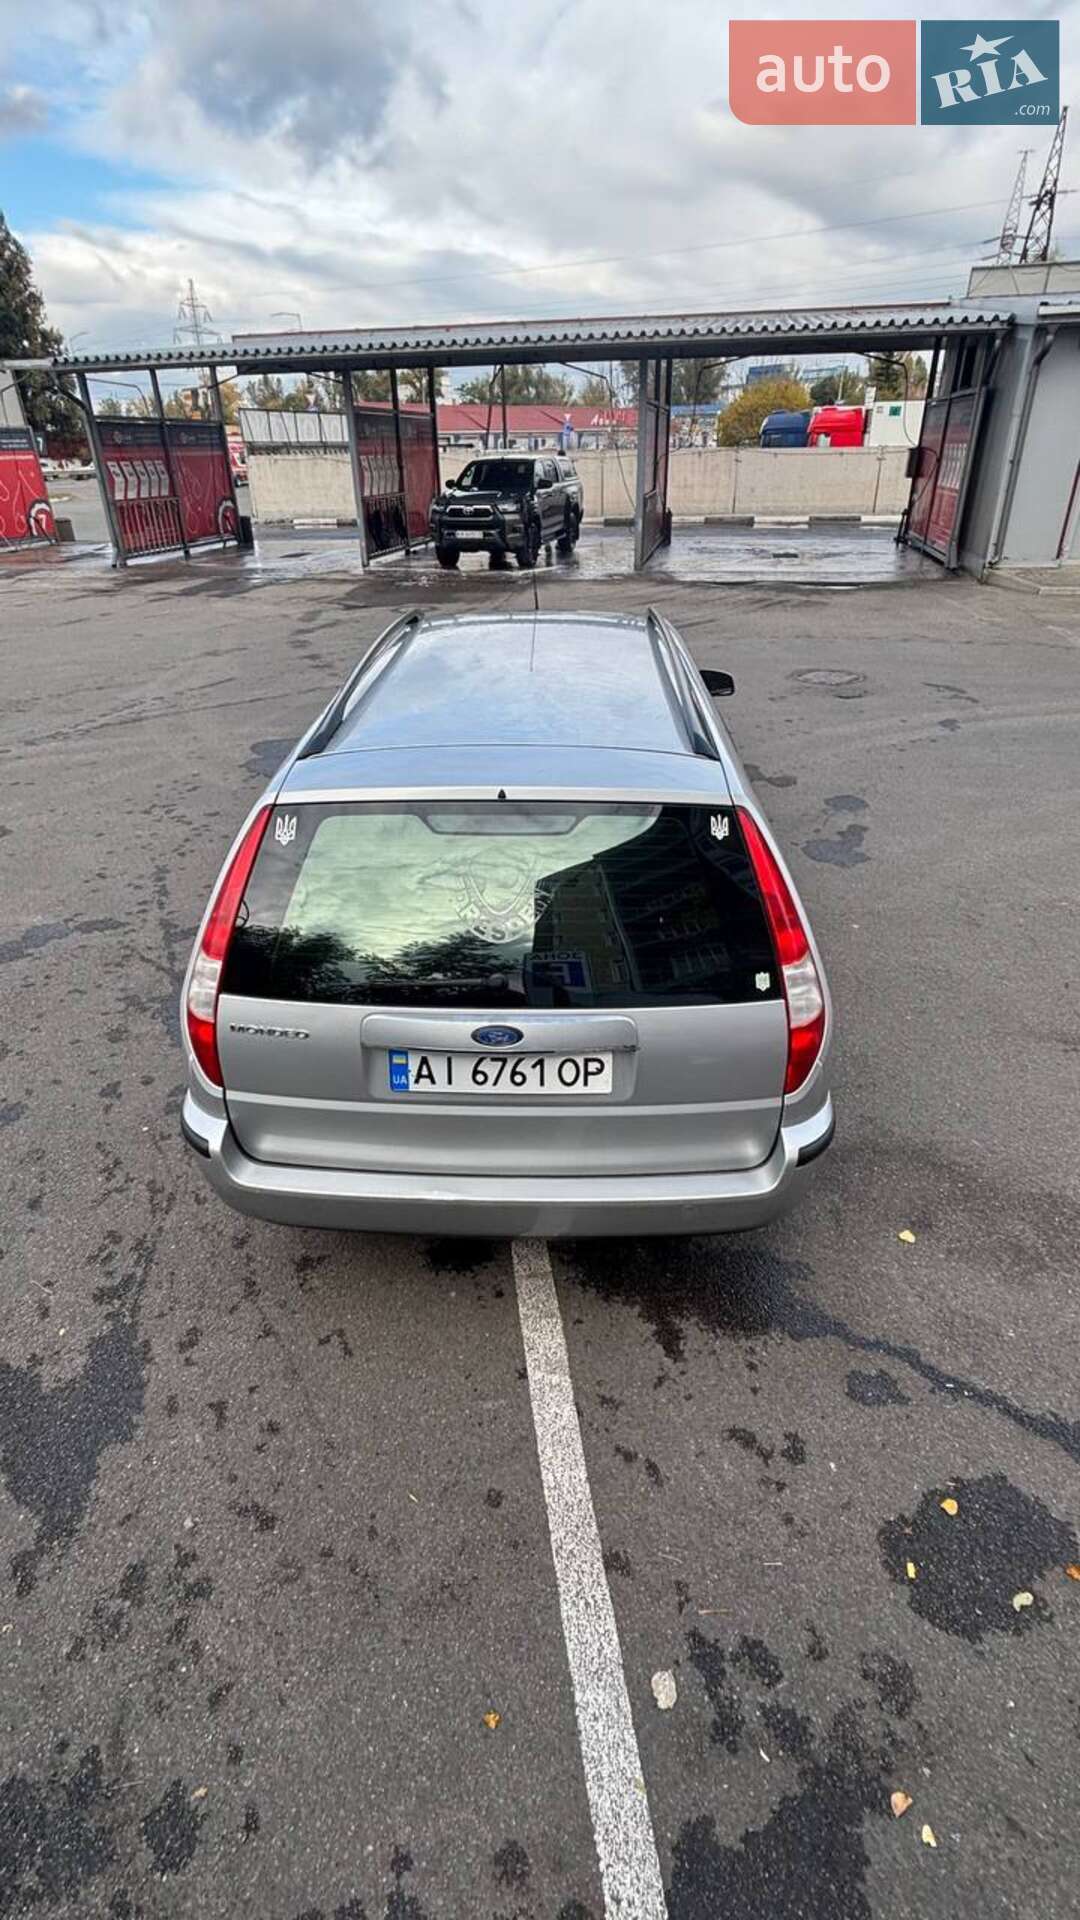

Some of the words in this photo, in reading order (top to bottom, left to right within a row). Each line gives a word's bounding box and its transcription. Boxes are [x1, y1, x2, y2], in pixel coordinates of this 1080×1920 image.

[229, 1022, 310, 1040] MONDEO
[392, 1074, 408, 1085] UA
[413, 1055, 453, 1086] AI
[470, 1056, 545, 1088] 6761
[557, 1057, 605, 1088] OP
